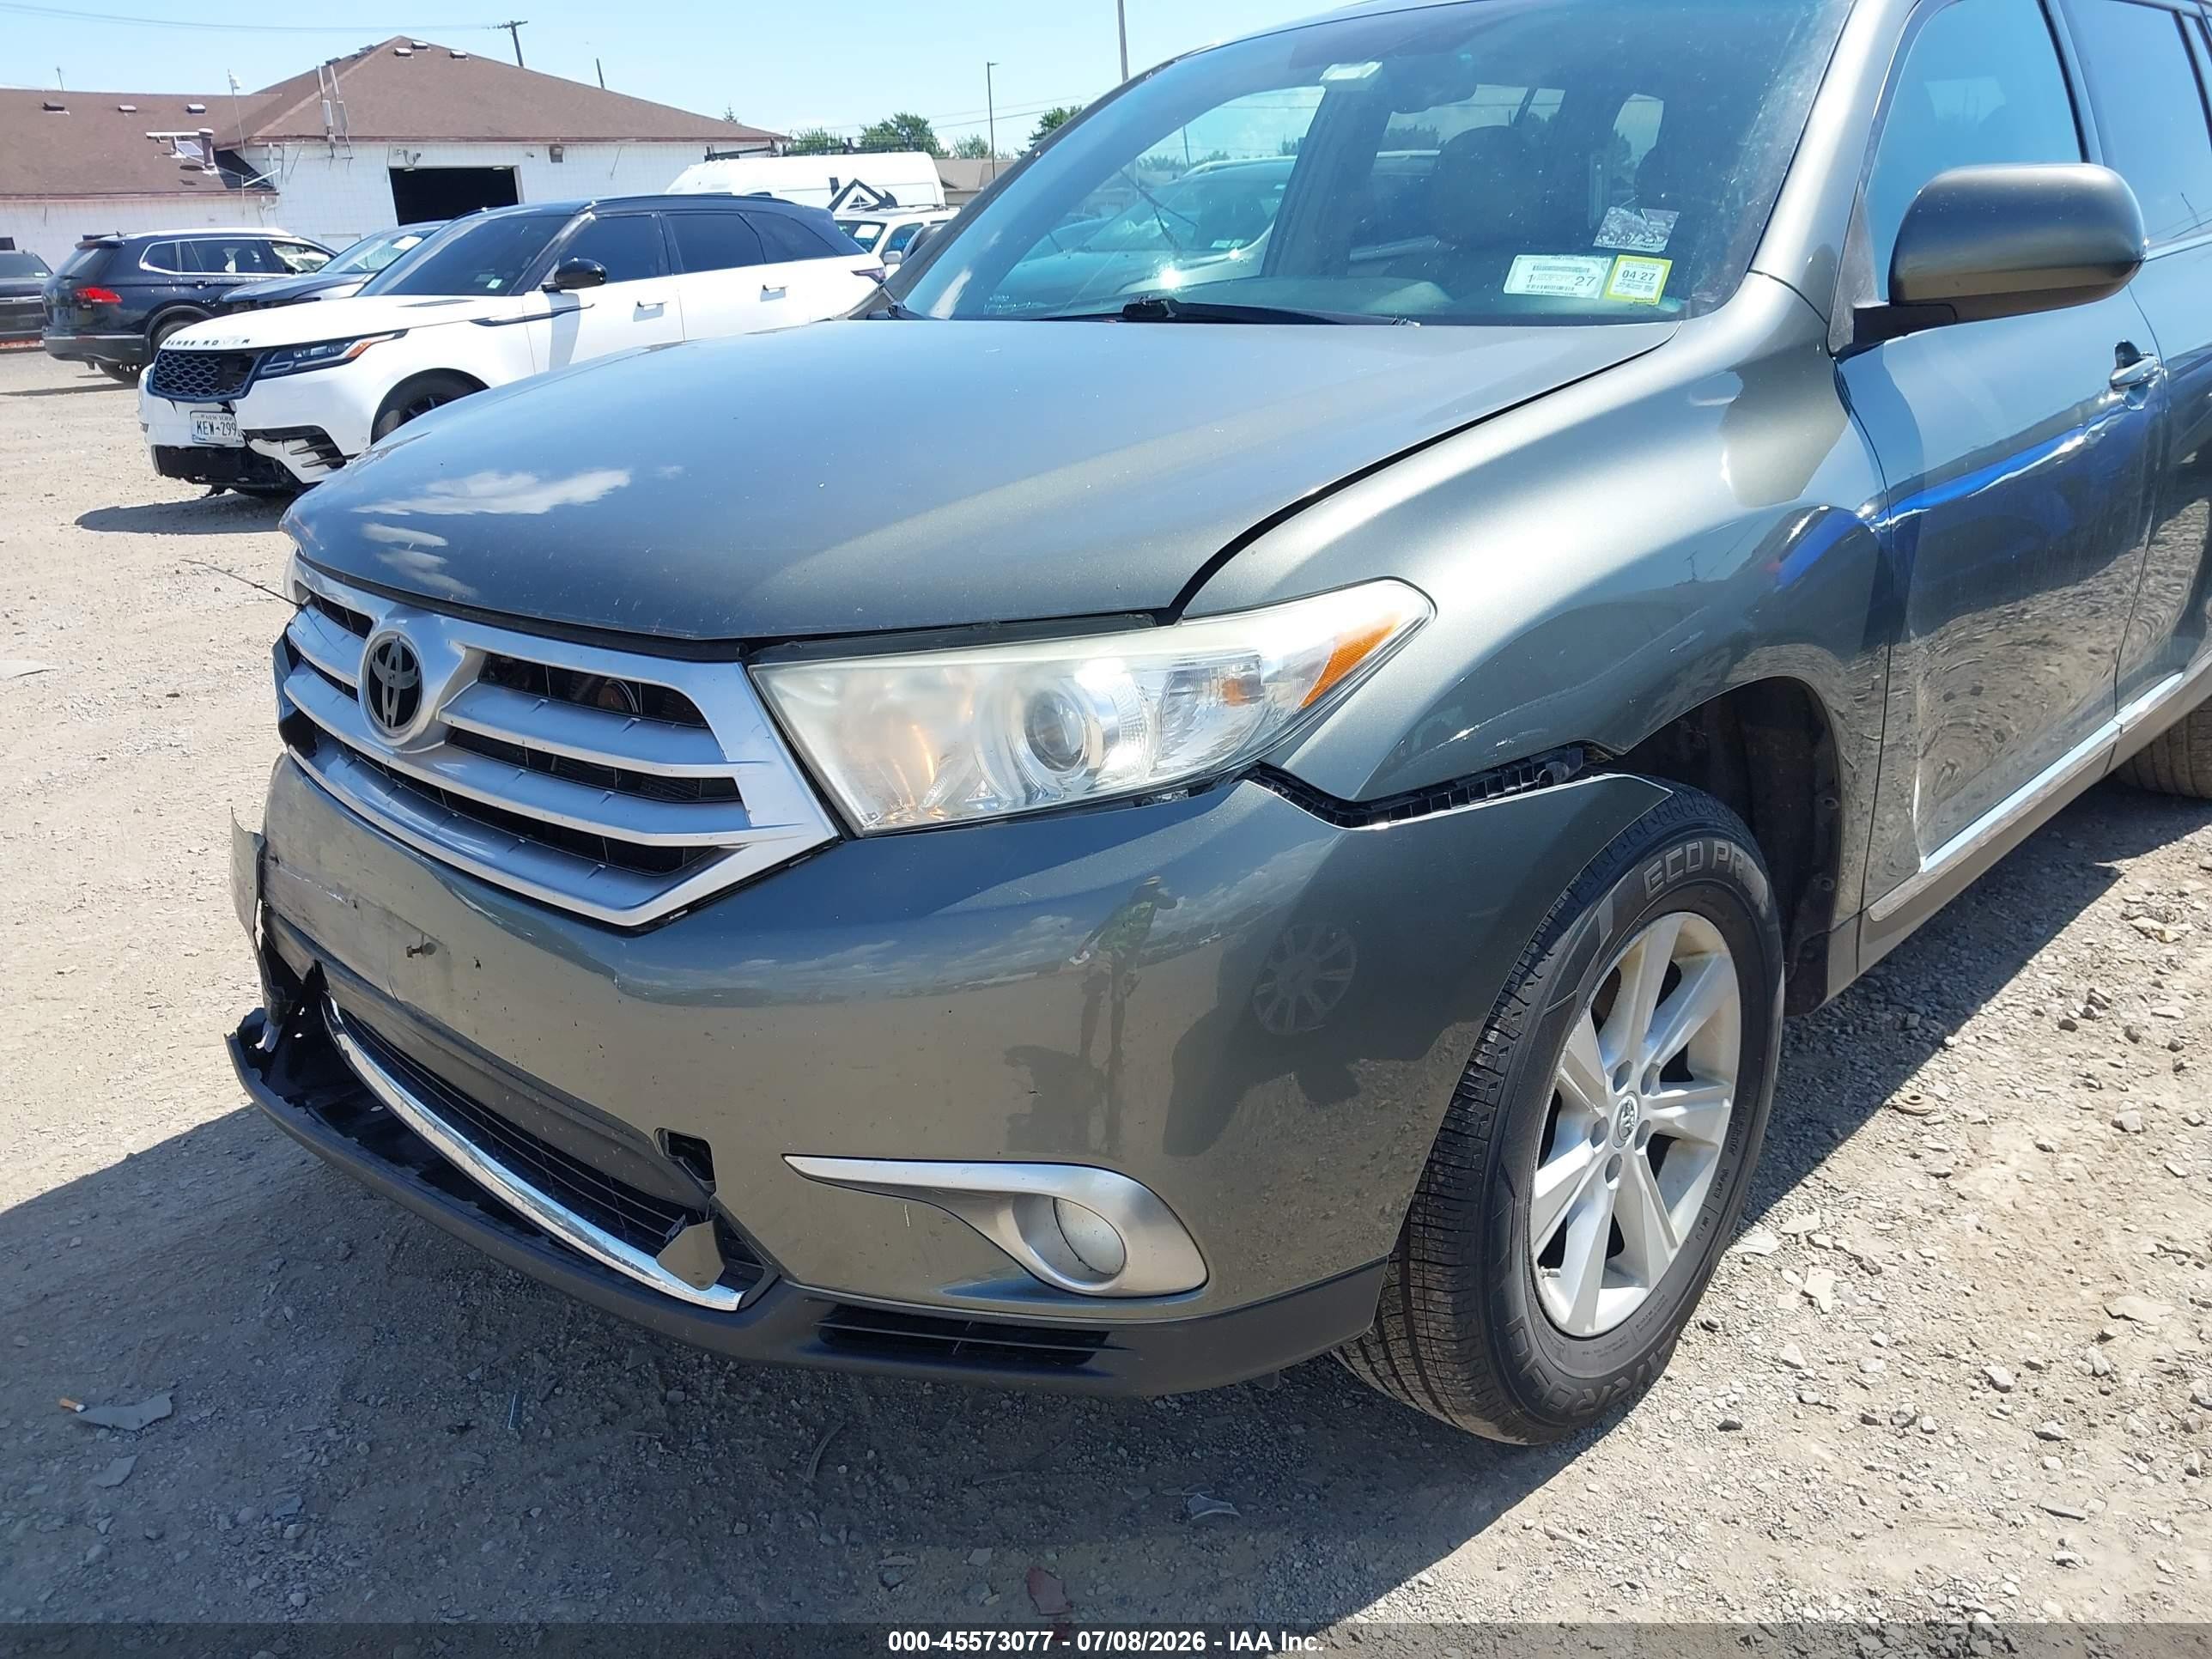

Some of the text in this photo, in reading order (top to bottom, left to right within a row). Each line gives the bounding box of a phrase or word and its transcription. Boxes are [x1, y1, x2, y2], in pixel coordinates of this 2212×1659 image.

[1574, 276, 1597, 287] 27
[1622, 270, 1637, 279] 04
[1640, 271, 1656, 282] 27
[1644, 841, 1705, 901] ECO
